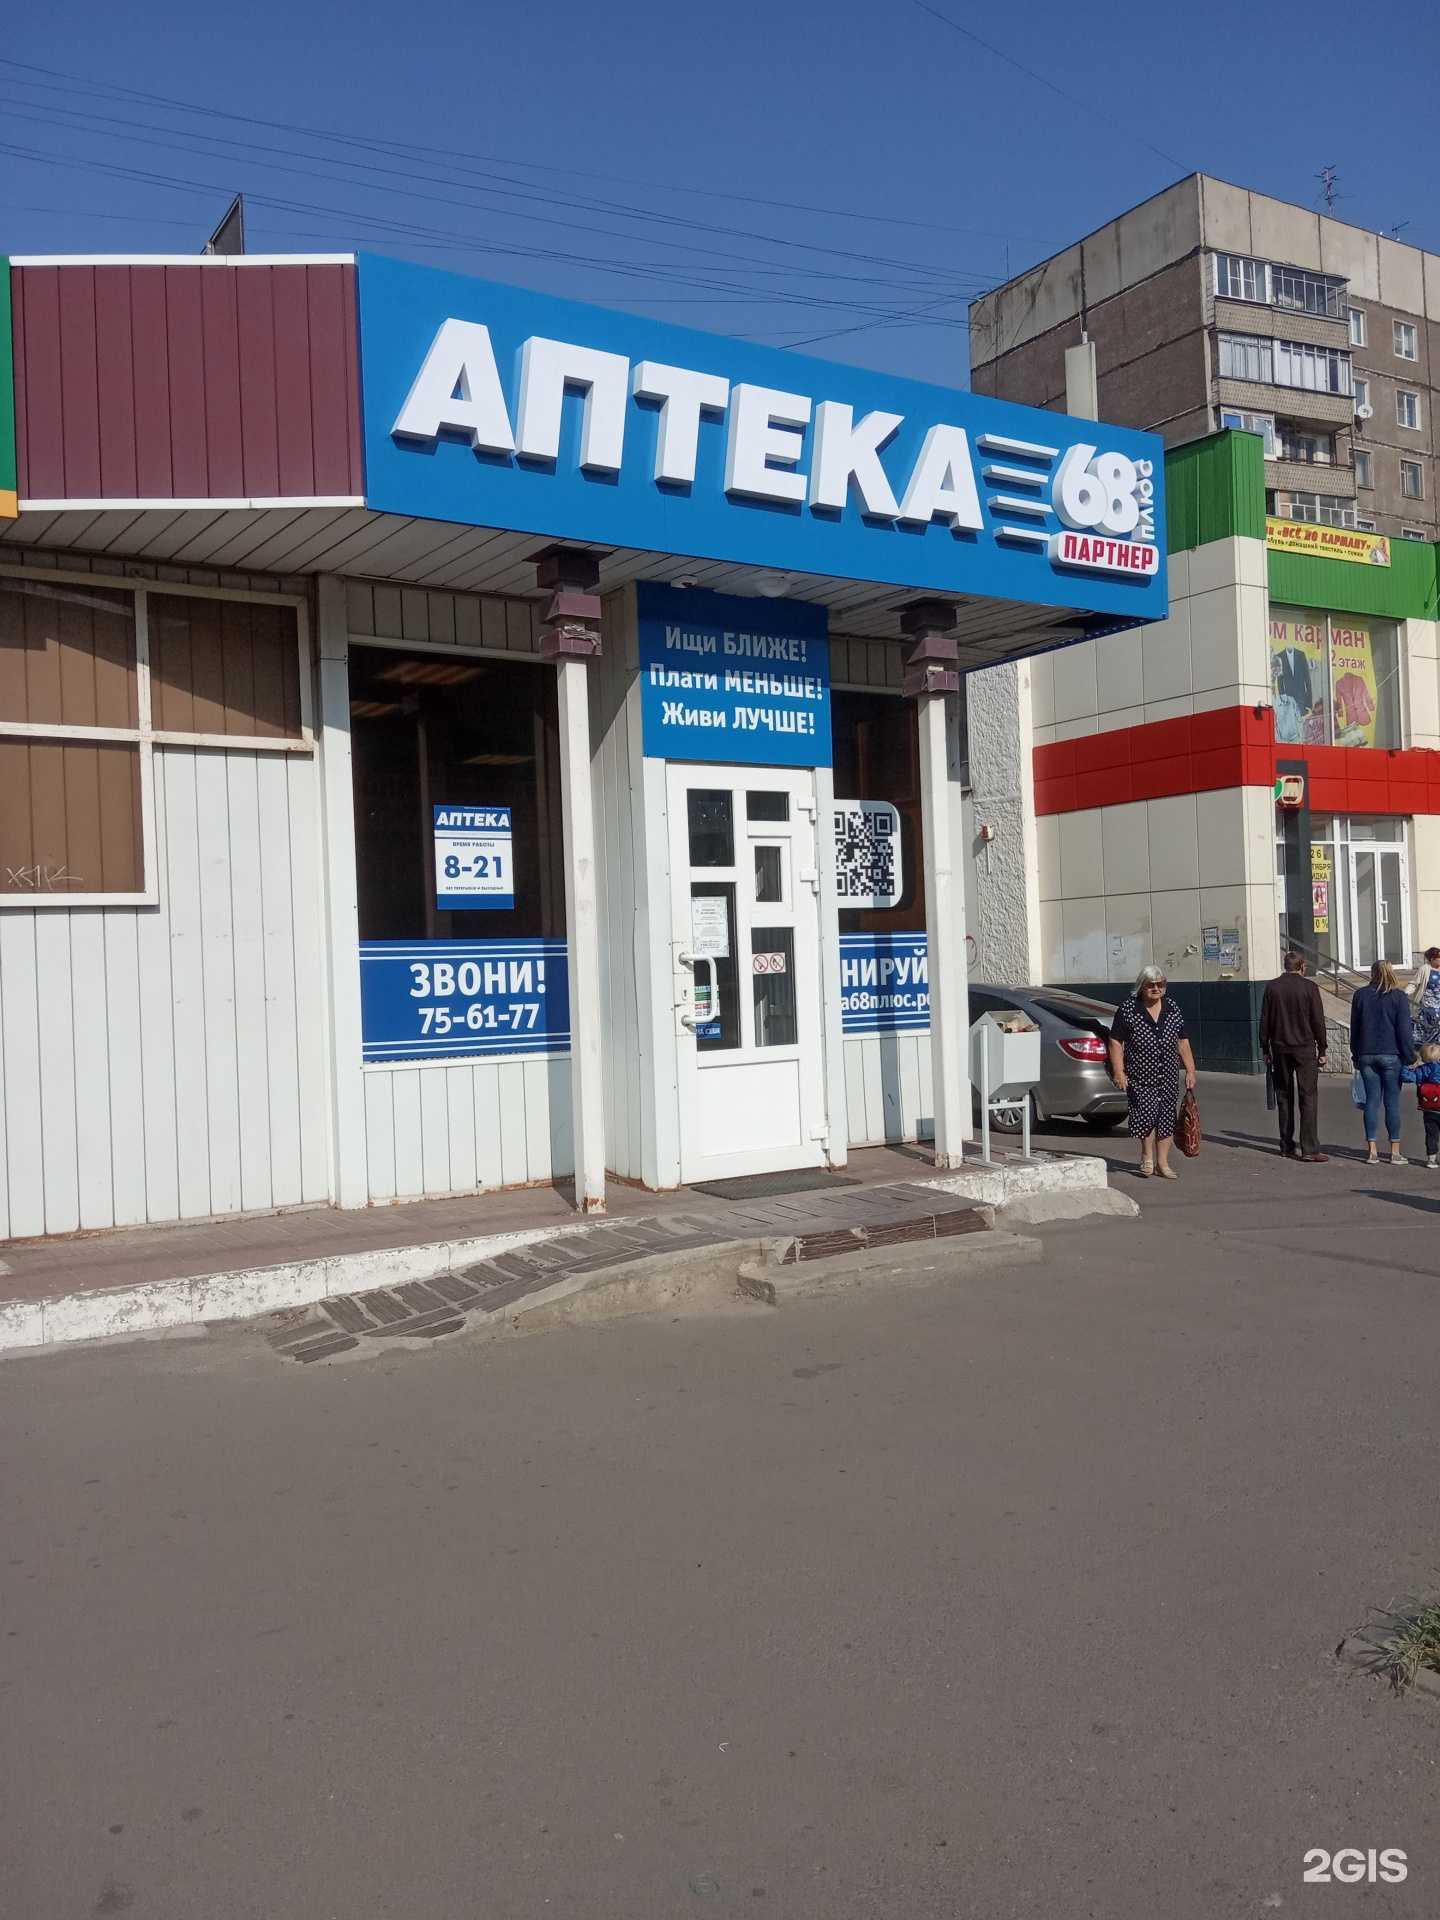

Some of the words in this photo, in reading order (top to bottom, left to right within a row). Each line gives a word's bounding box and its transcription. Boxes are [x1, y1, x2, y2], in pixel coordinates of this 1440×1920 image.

[391, 317, 983, 532] АПТЕКА
[1052, 443, 1139, 537] 68
[1063, 534, 1154, 571] ПАРТНЕР
[665, 625, 716, 655] Ищи
[723, 632, 807, 663] БЛИЖЕ!
[650, 663, 718, 690] Плати
[725, 669, 823, 700] МЕНЬШЕ!
[661, 701, 726, 728] Живи
[733, 706, 815, 735] ЛУЧШЕ!
[436, 811, 510, 828] АПТЕКА
[444, 855, 502, 878] 8-21
[409, 960, 546, 998] ЗВОНИ!
[841, 948, 928, 987] НИРУЙ
[418, 1003, 540, 1034] 75-61-77
